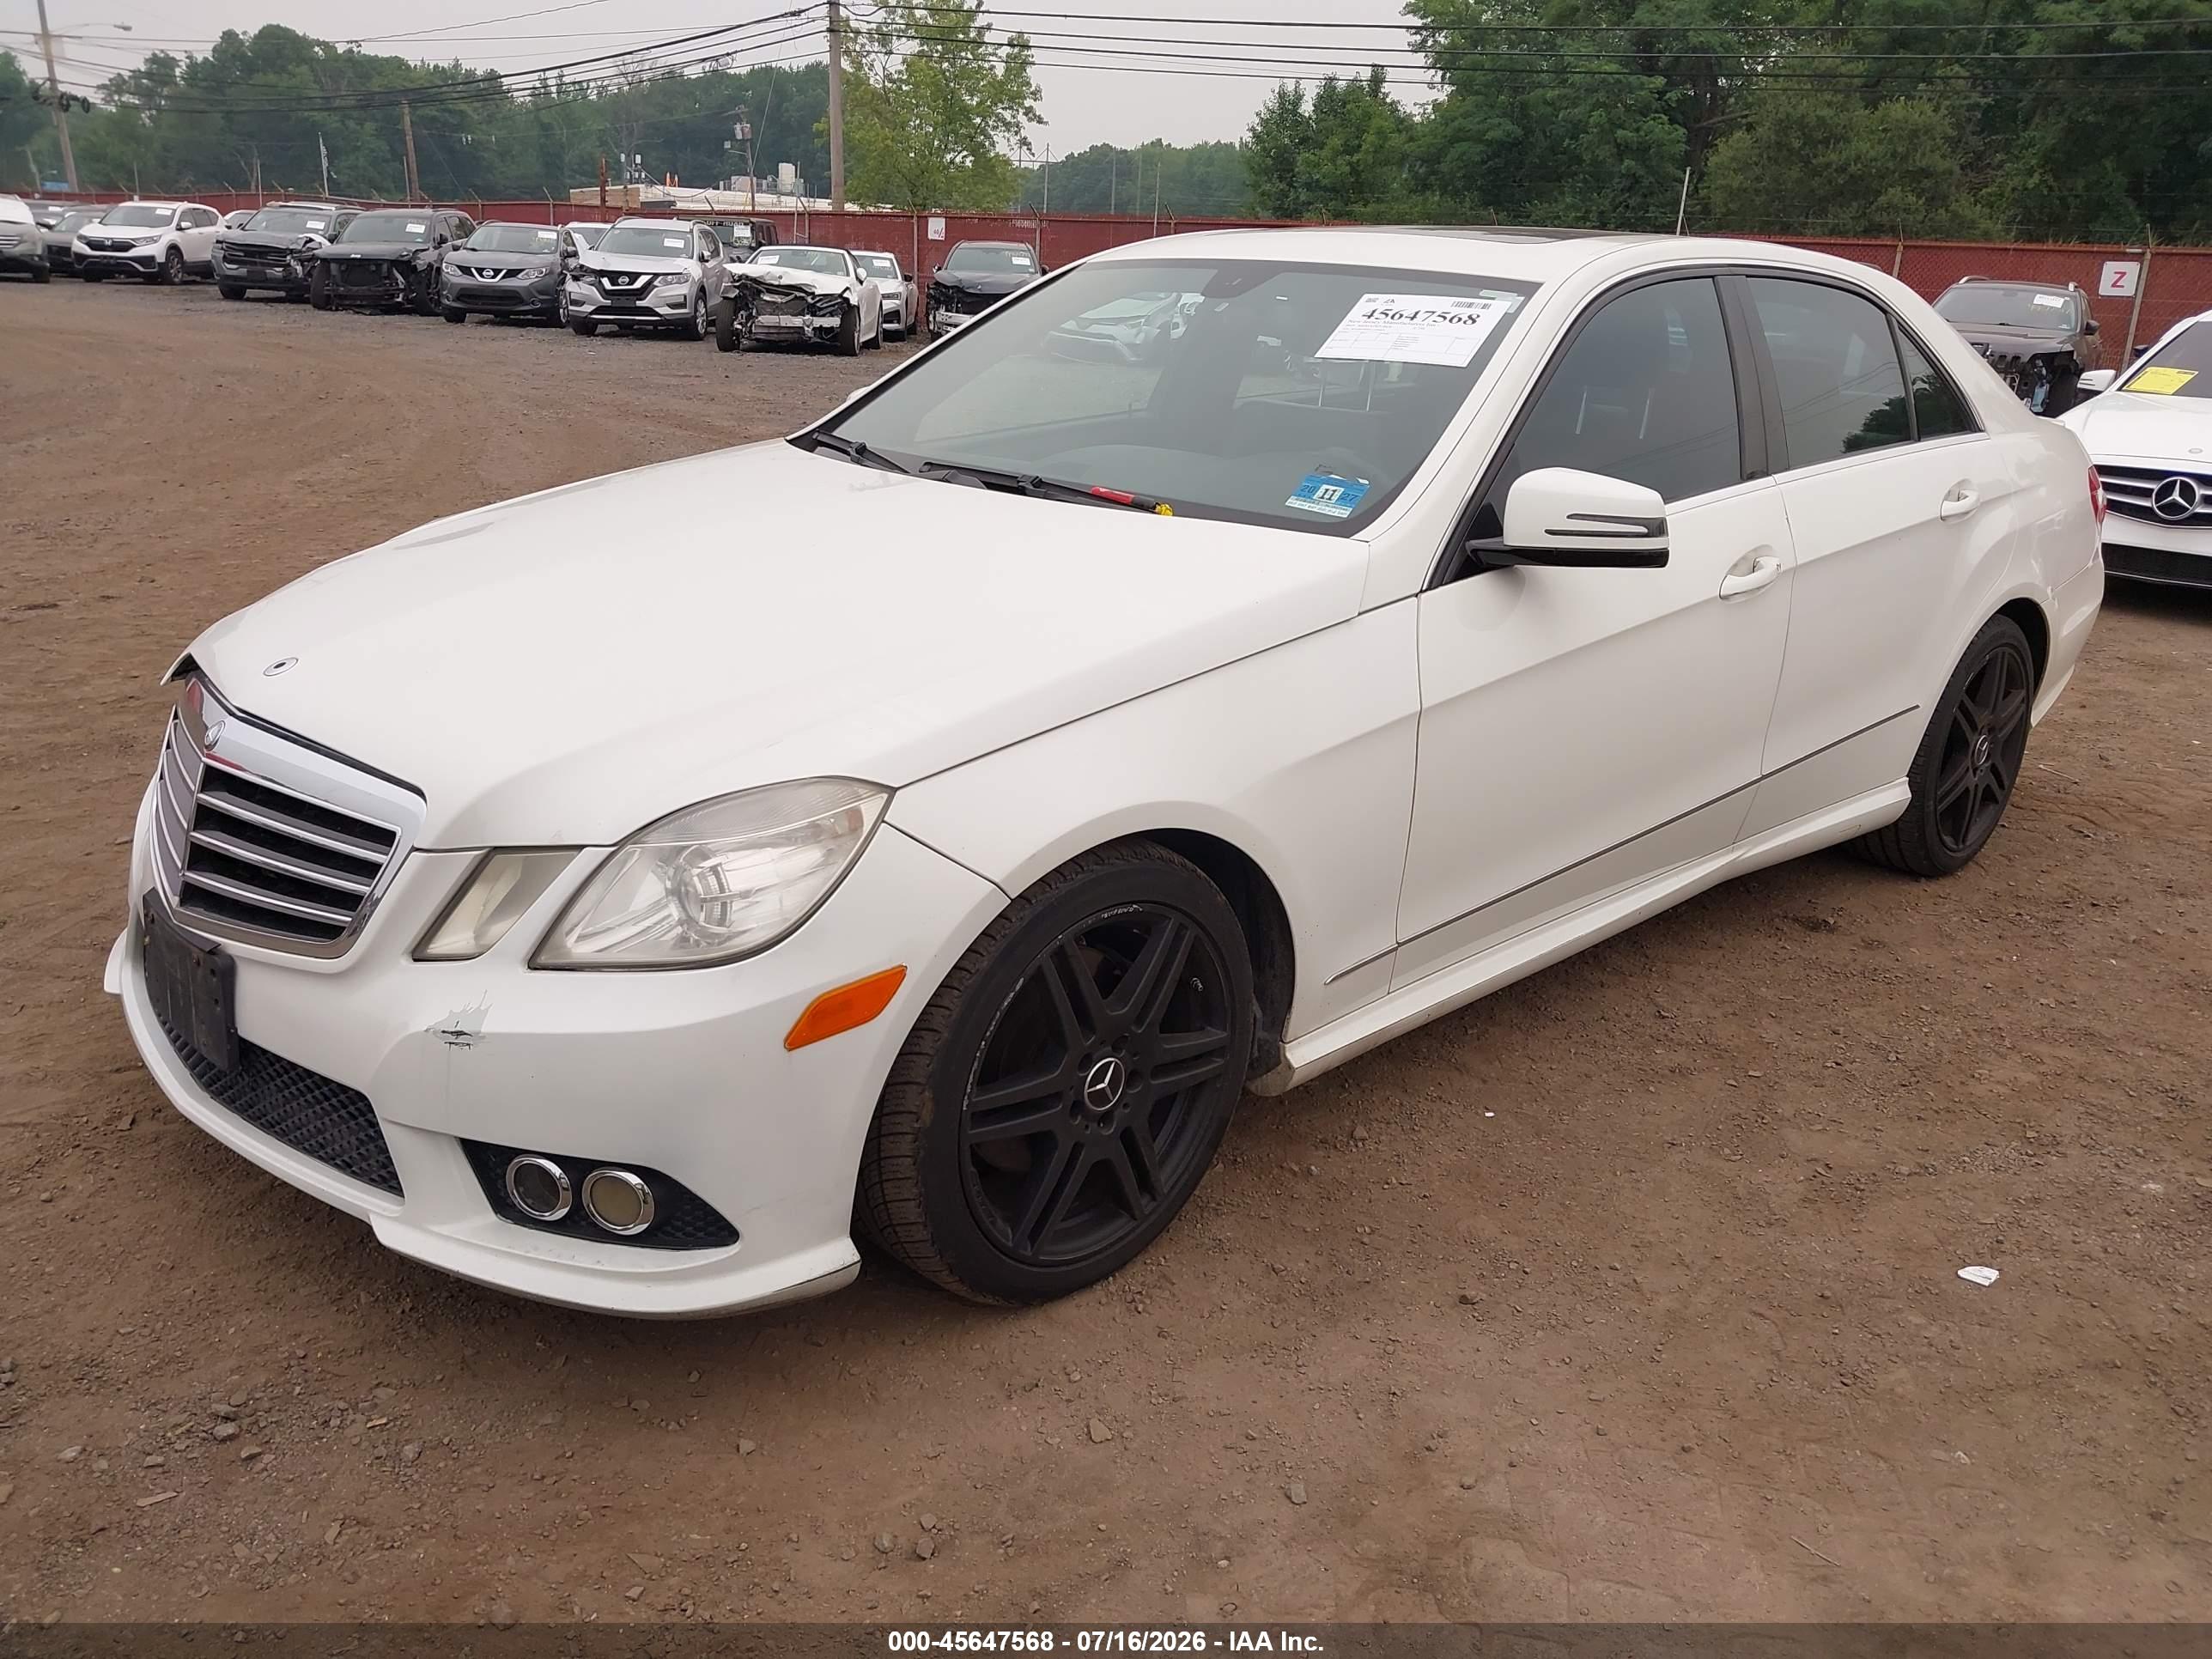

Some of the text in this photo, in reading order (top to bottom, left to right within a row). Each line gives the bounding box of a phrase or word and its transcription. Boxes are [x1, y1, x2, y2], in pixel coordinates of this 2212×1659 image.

[2111, 271, 2127, 288] Z
[1362, 307, 1481, 325] 45647568
[1301, 484, 1316, 493] 20
[1318, 488, 1337, 501] 11
[1340, 493, 1358, 502] 27
